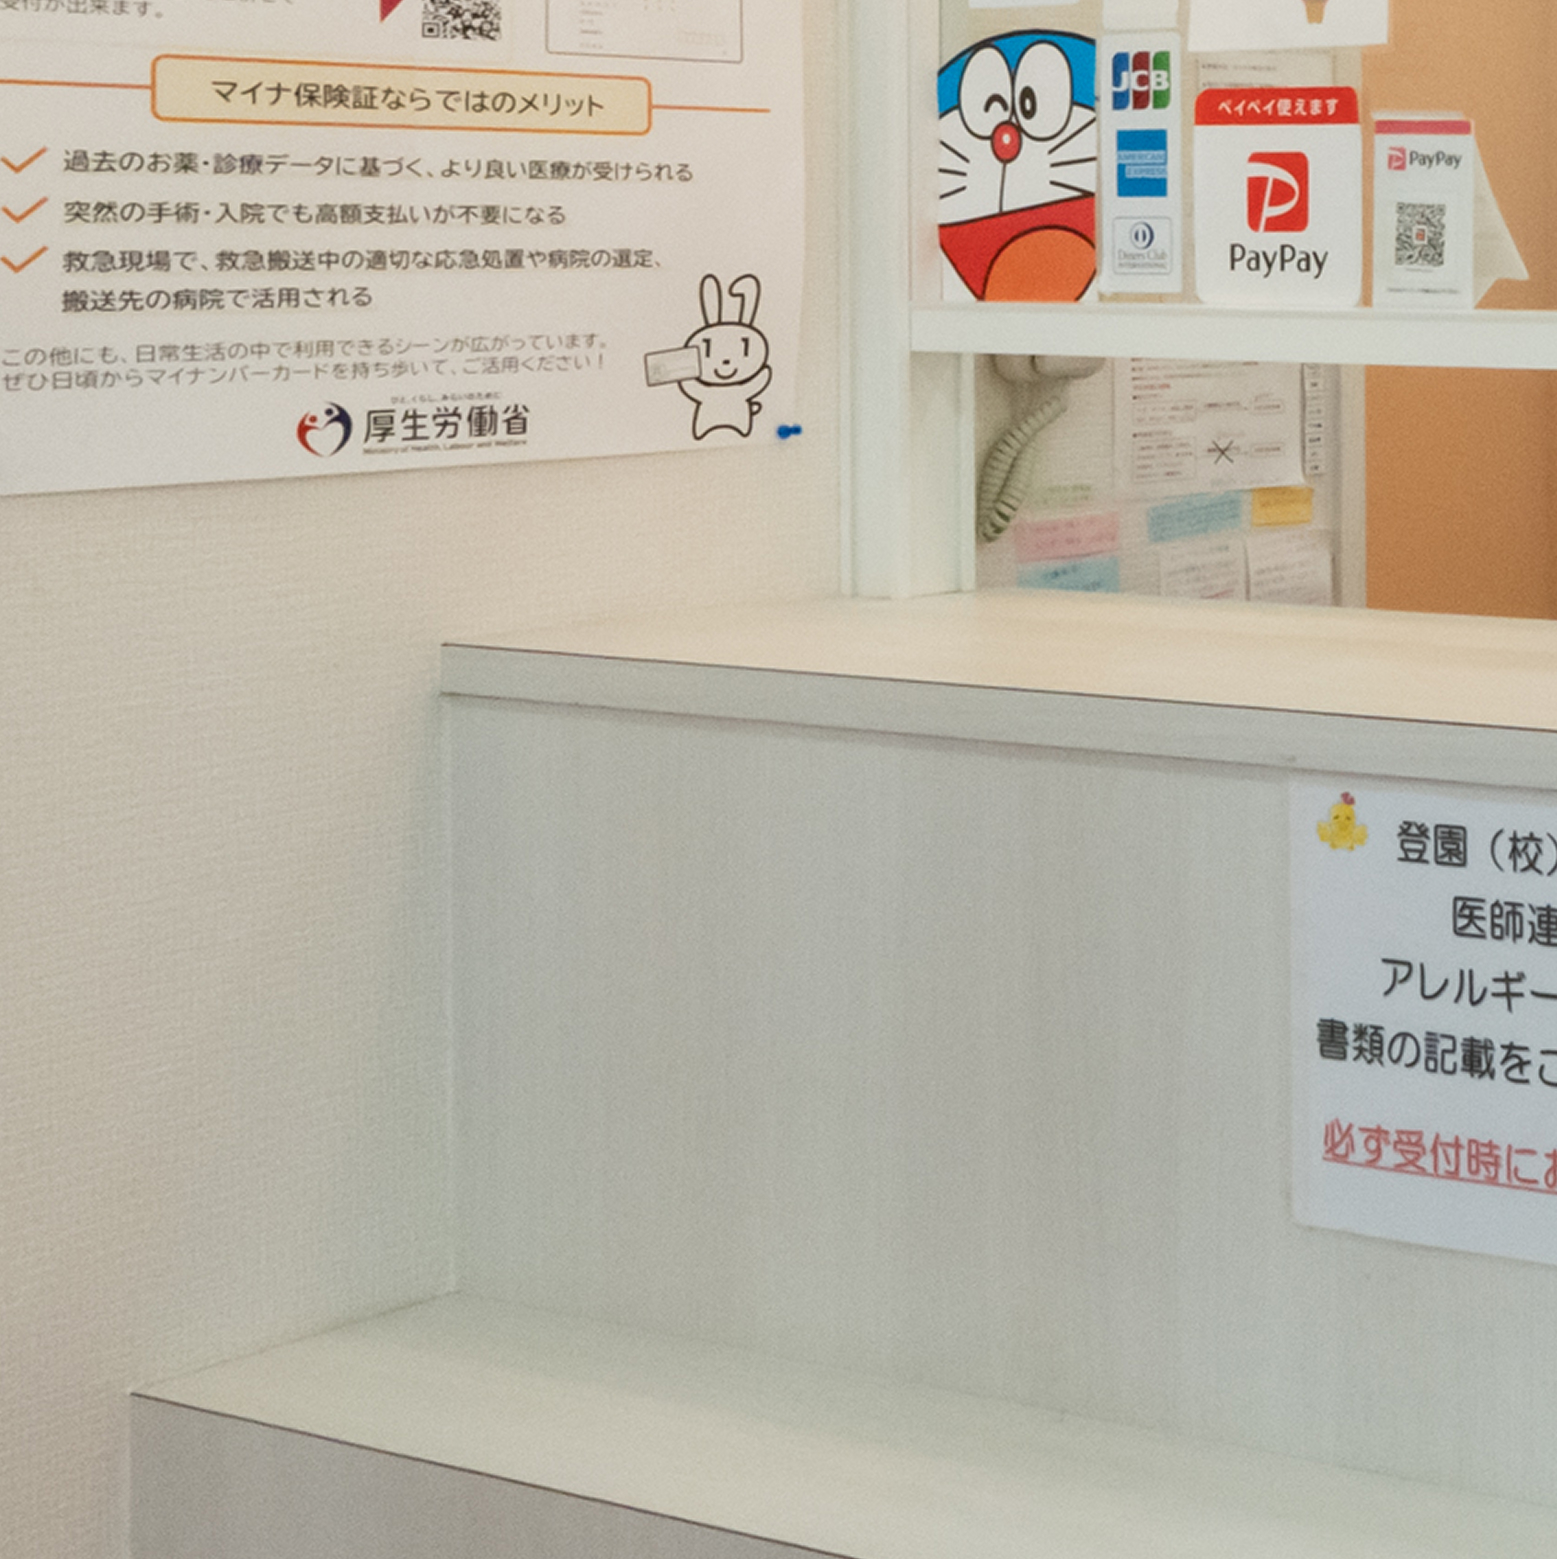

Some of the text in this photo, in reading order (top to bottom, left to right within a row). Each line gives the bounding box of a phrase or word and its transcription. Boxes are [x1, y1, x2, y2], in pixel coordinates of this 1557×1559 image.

[1112, 69, 1170, 93] JCB
[211, 79, 605, 118] マイナ保険証ならではのメリット
[1218, 98, 1339, 117] ペイペイ使えます
[1409, 150, 1462, 170] PayPay
[1229, 243, 1329, 280] PayPay
[61, 286, 373, 313] 搬送先の病院で活用される
[364, 404, 530, 444] 厚生労働省
